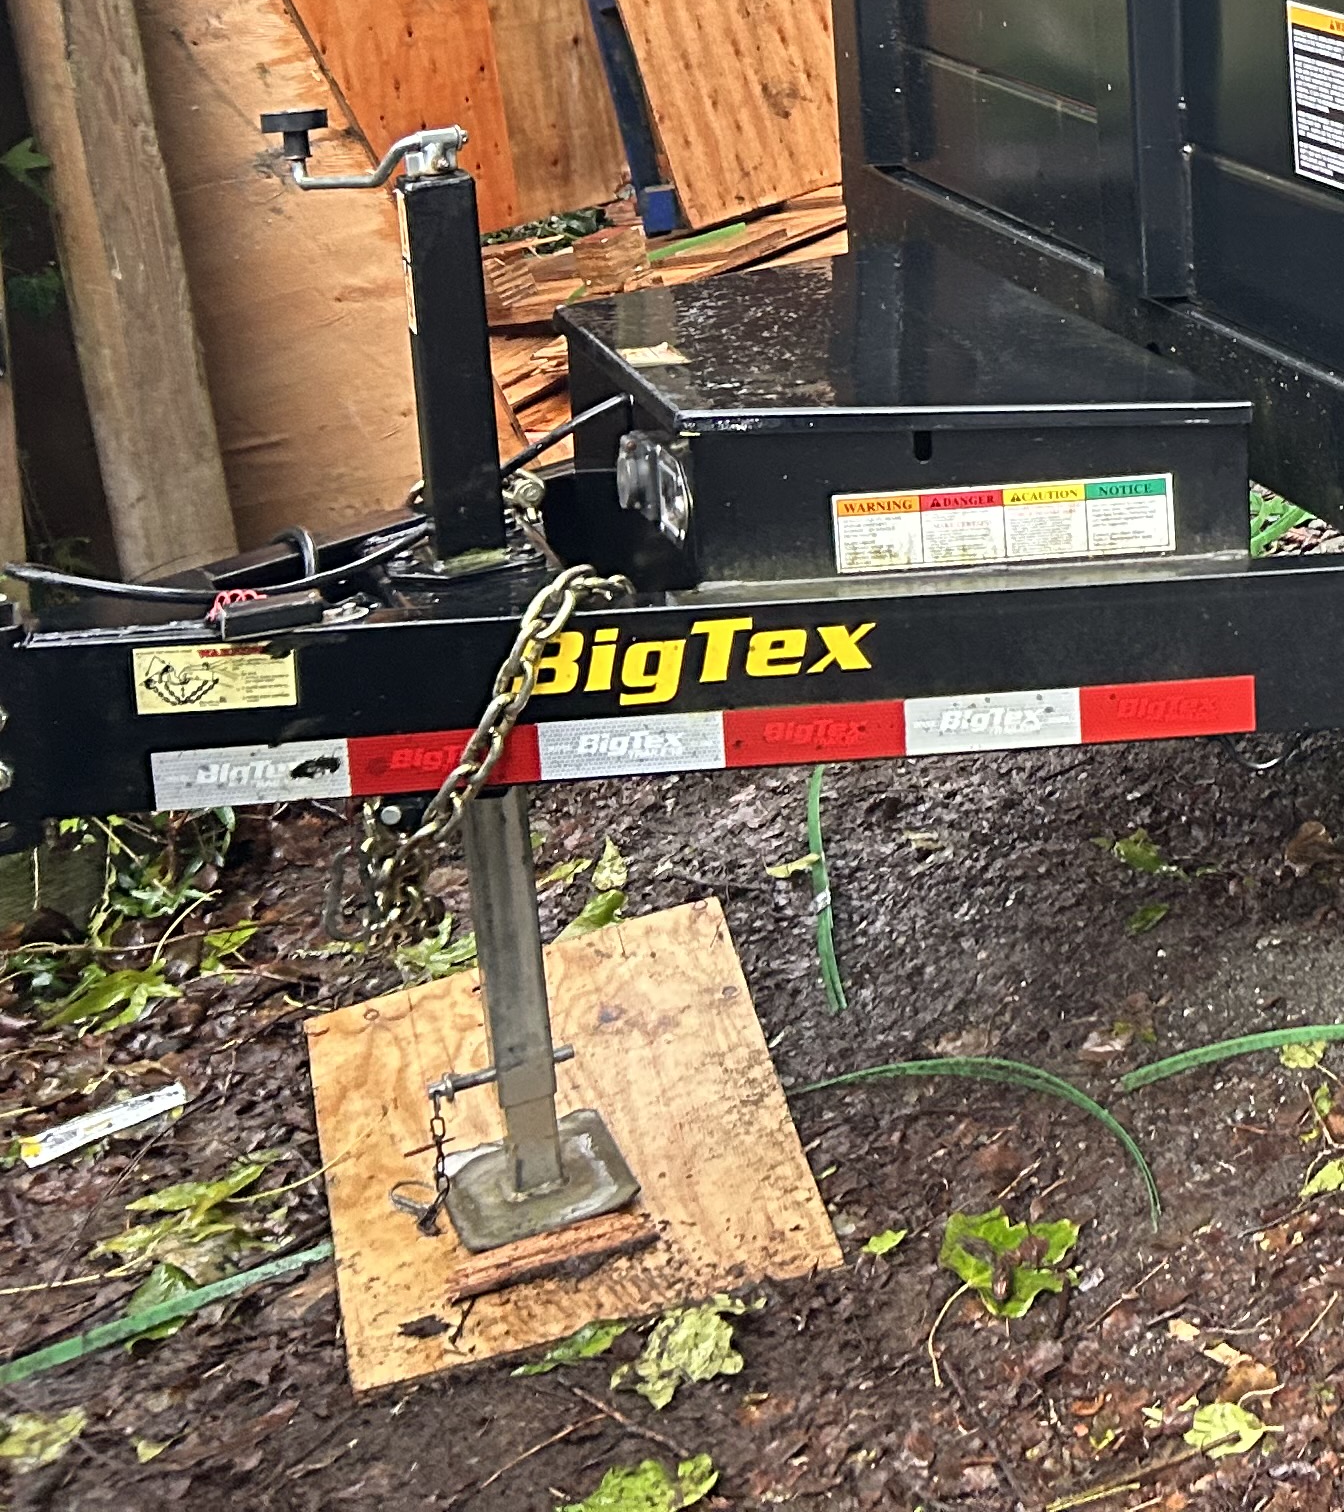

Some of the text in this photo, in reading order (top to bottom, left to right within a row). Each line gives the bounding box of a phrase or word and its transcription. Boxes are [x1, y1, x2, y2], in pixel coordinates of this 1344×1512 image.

[943, 495, 995, 508] DANGER
[1021, 489, 1079, 502] CAUTION
[1098, 482, 1153, 496] NOTICE
[843, 498, 913, 514] WARNING
[511, 617, 877, 706] BigTex
[763, 719, 868, 745] BigTex
[938, 704, 1043, 734] BigTex
[577, 730, 686, 757] BigTex
[390, 744, 464, 771] BigT
